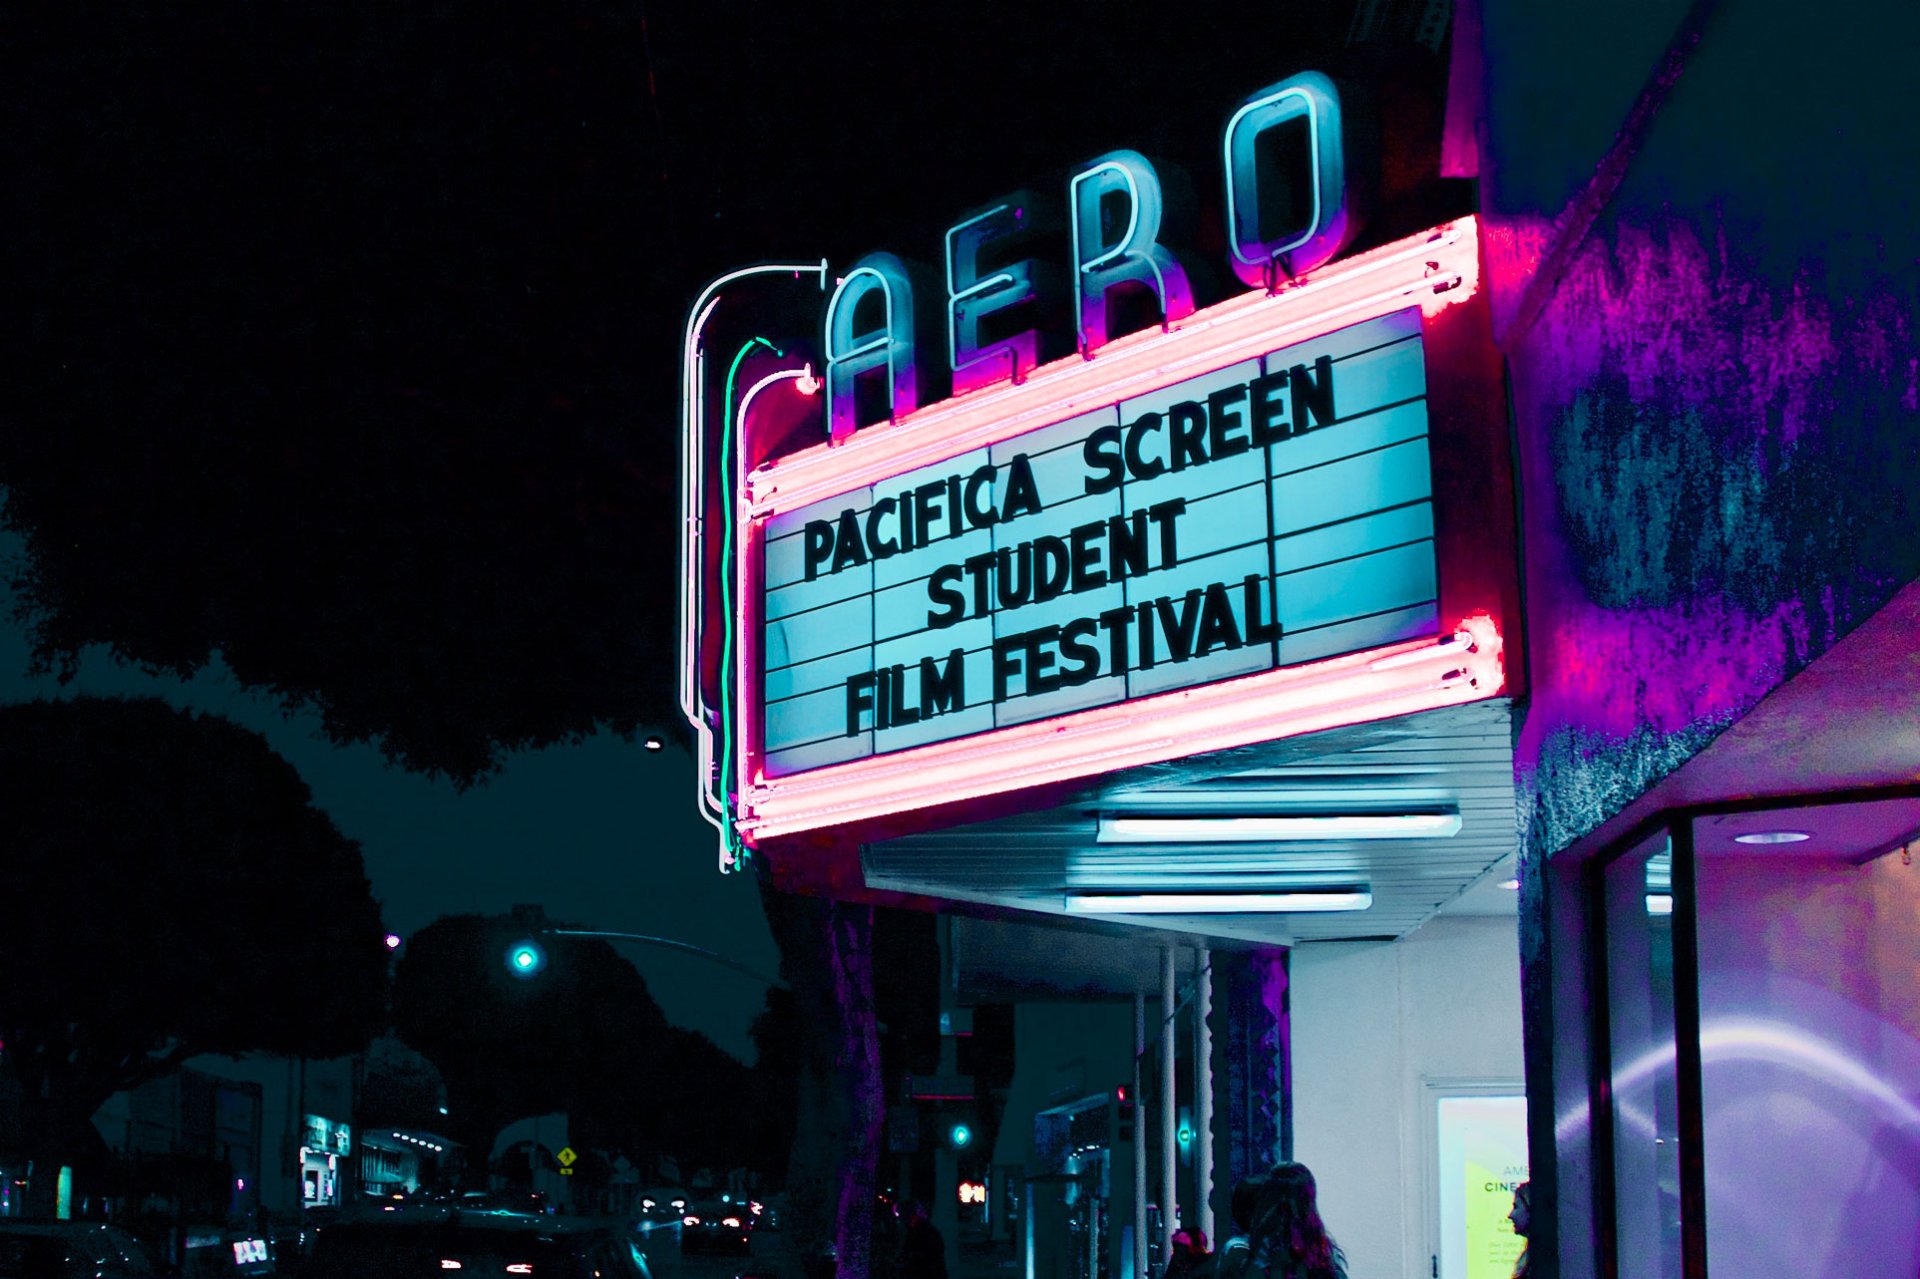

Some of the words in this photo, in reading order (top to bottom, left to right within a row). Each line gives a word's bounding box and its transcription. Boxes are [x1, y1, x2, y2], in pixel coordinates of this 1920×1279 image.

[826, 70, 1346, 446] AERO
[804, 453, 1042, 582] PACIFICA
[1083, 355, 1335, 495] SCREEN
[928, 497, 1186, 629] STUDENT
[846, 648, 965, 738] FILM
[995, 574, 1283, 702] FESTIVAL
